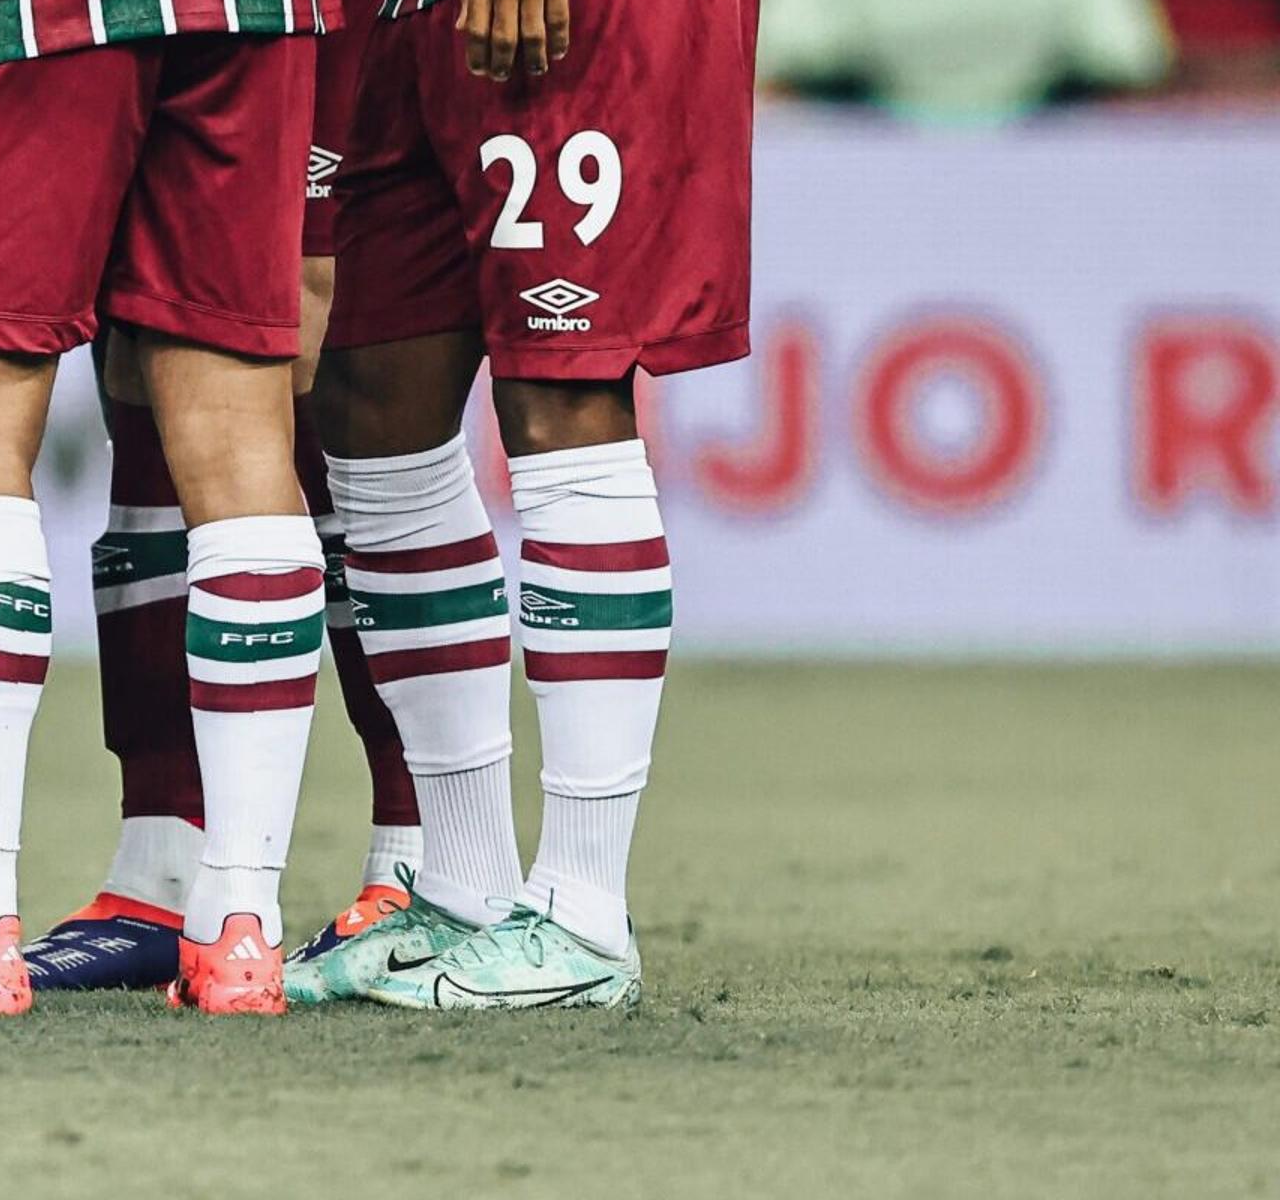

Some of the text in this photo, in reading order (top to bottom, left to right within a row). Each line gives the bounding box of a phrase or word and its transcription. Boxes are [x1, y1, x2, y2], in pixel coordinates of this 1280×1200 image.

[479, 129, 623, 249] 29
[527, 314, 591, 332] umbro
[220, 630, 294, 647] FFC
